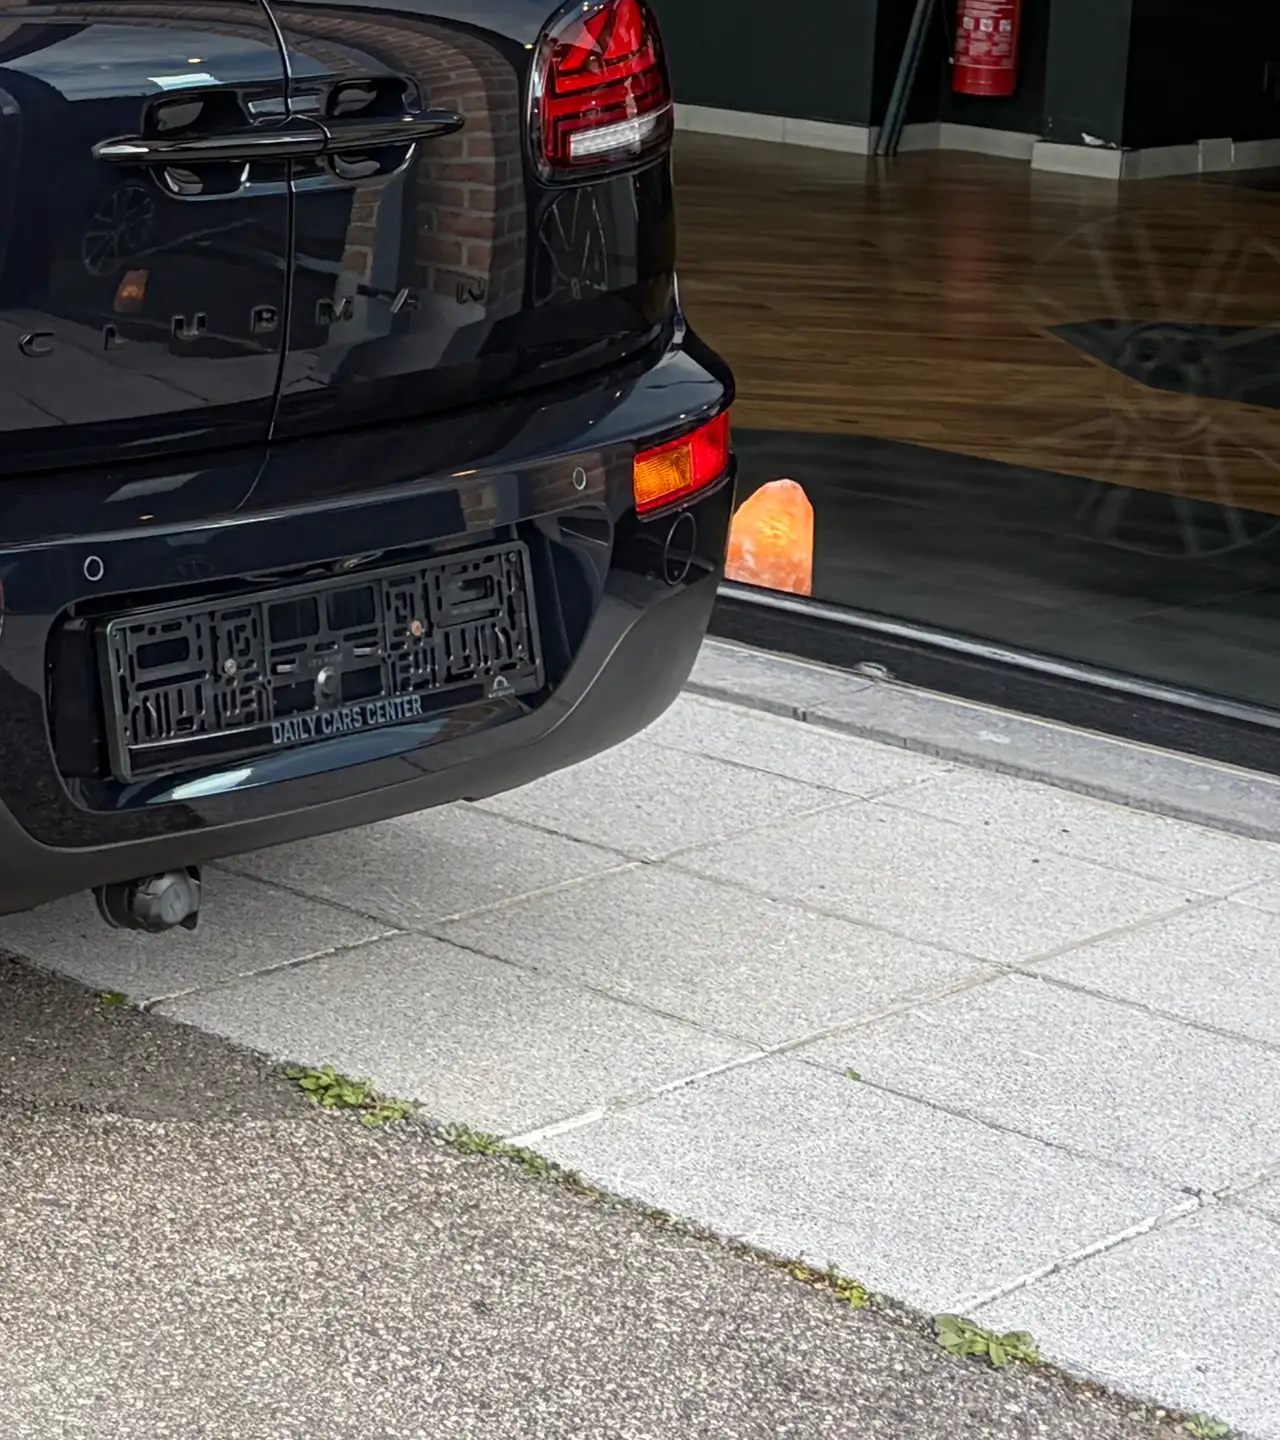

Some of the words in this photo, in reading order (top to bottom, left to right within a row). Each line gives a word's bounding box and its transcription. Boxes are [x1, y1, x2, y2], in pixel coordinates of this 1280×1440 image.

[270, 718, 317, 745] DAILY
[320, 707, 364, 734] CARS
[366, 694, 424, 725] CENTER
